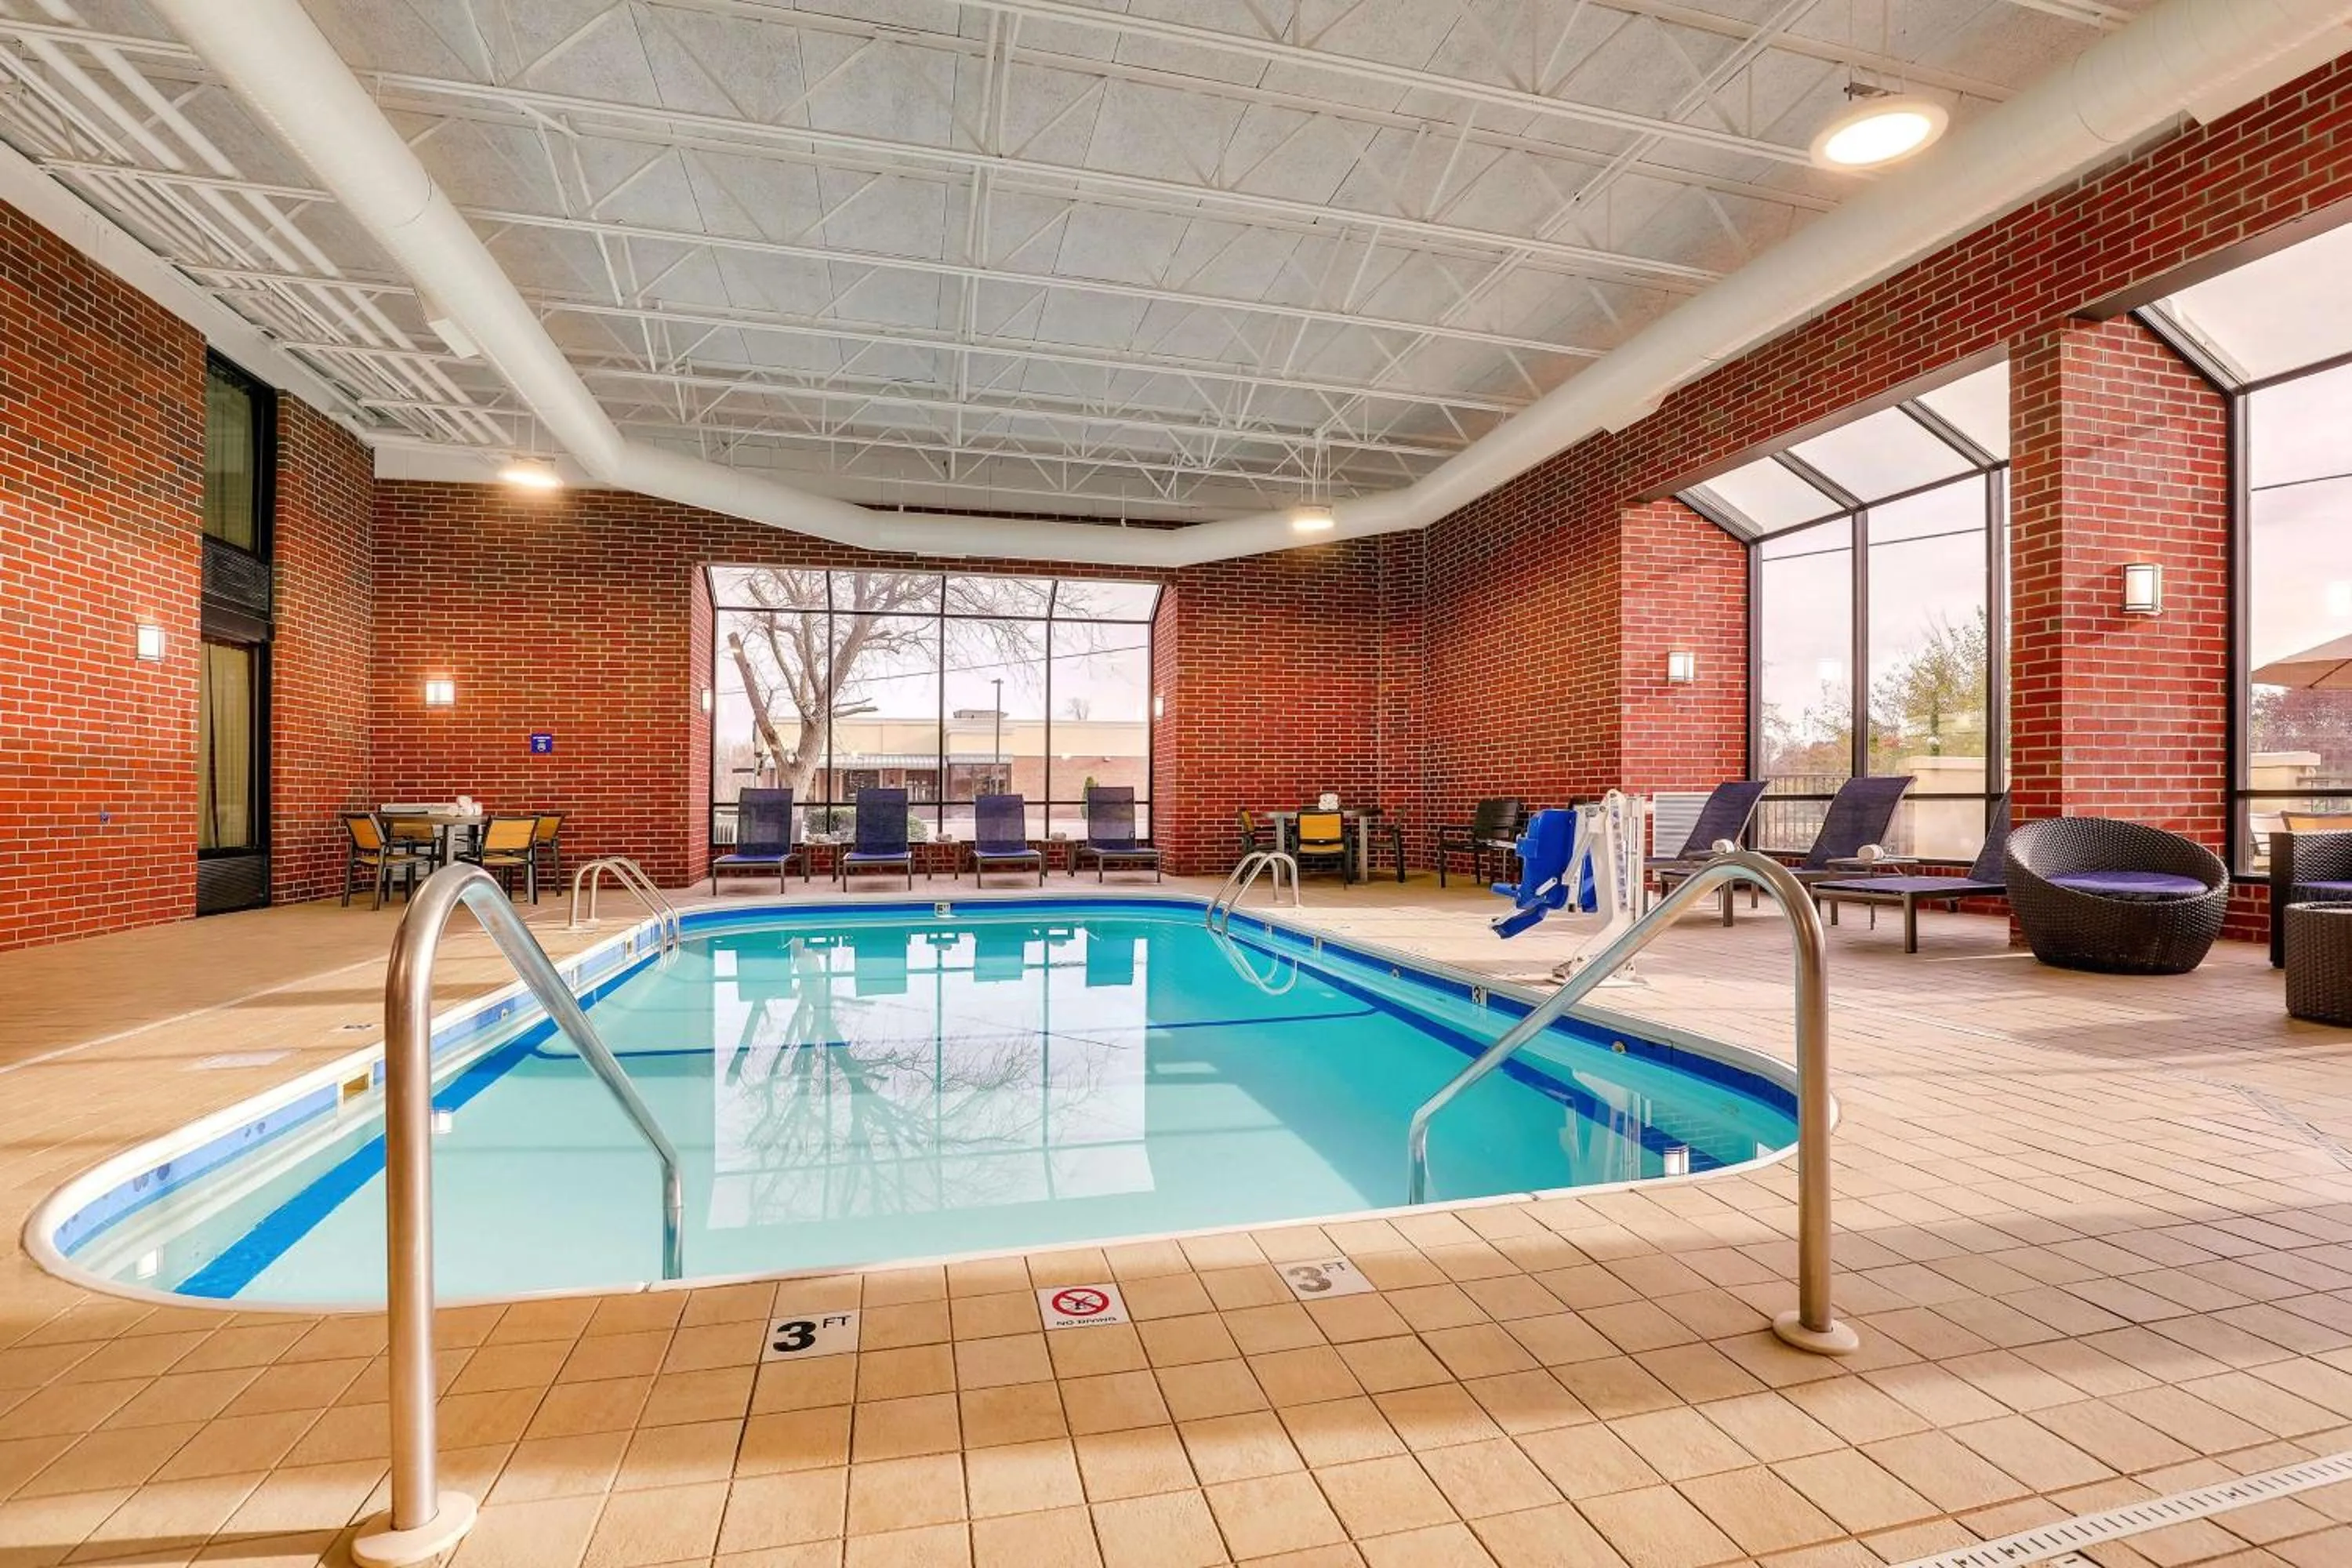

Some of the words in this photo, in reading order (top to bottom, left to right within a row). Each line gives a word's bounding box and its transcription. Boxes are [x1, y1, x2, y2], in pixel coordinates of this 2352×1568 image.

[1287, 1266, 1332, 1292] 3
[1321, 1261, 1345, 1272] FT
[772, 1321, 817, 1352] 3
[822, 1315, 852, 1328] FT
